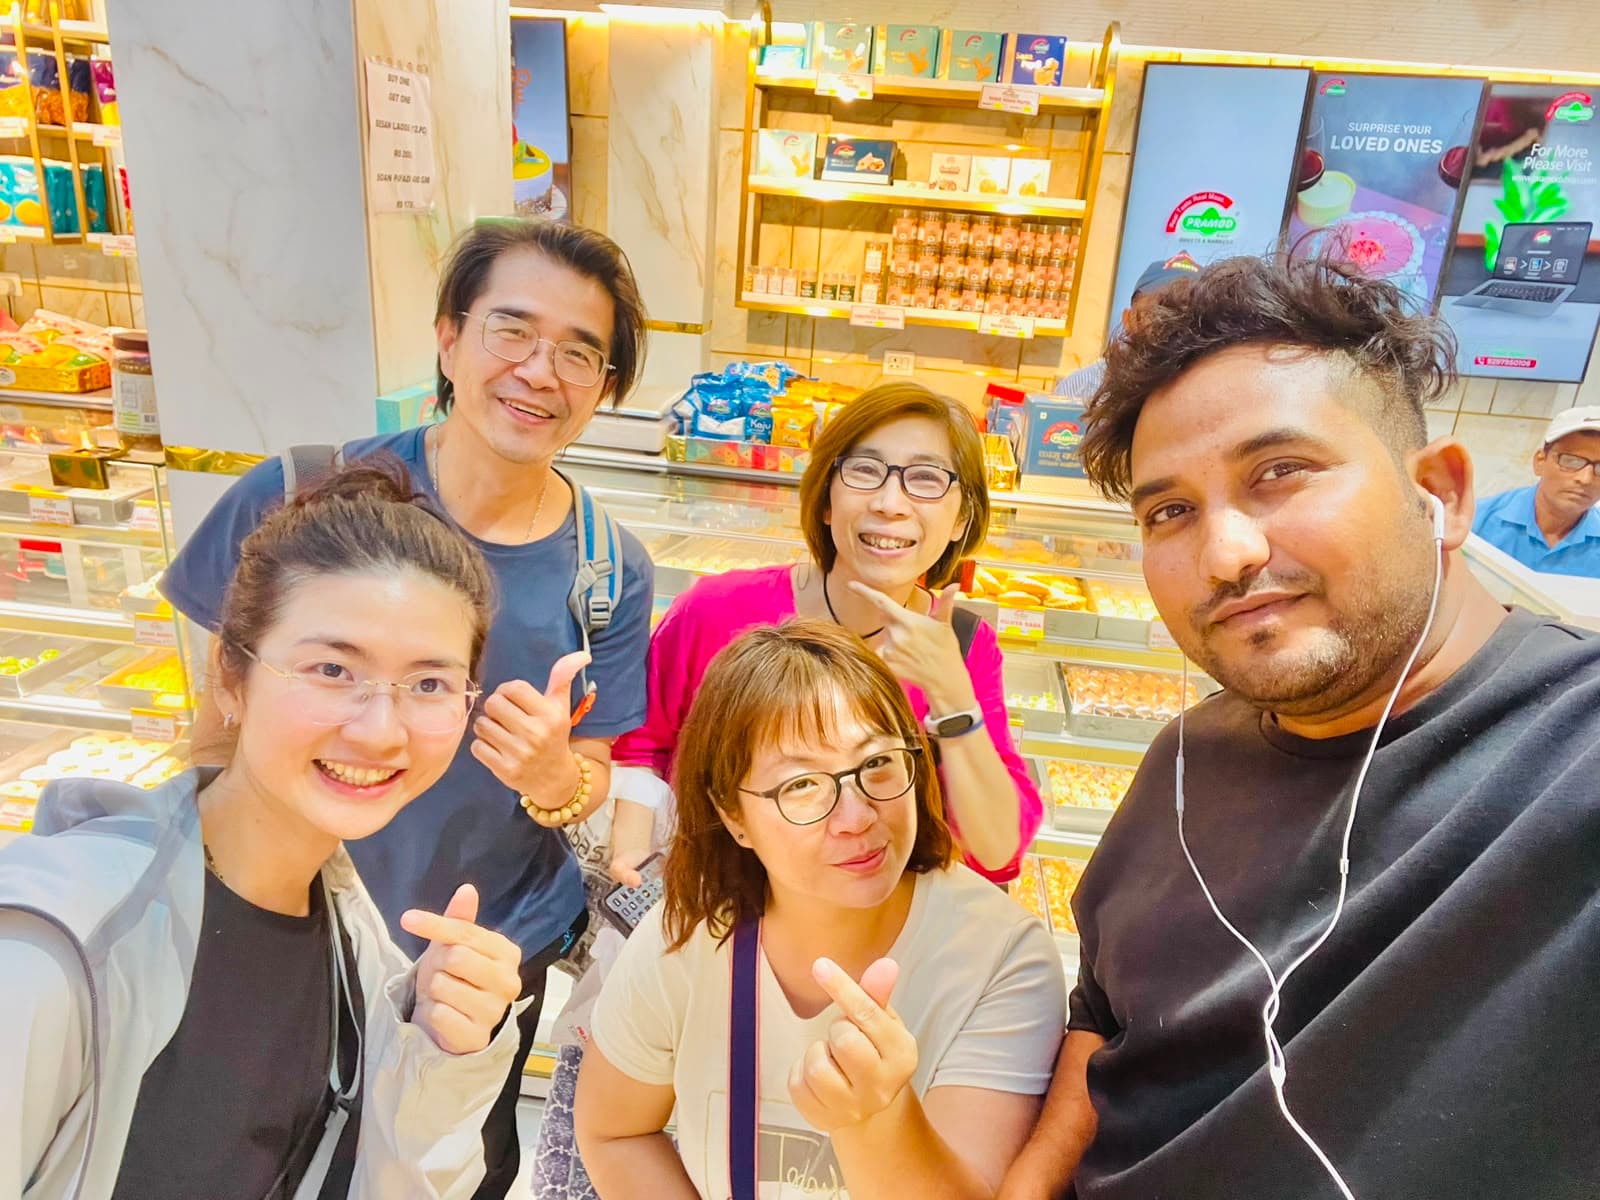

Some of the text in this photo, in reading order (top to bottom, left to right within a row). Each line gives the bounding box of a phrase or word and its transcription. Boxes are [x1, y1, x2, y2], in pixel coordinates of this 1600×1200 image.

[387, 73, 410, 87] BUY ONE
[388, 92, 411, 104] GET ONE
[1348, 122, 1432, 135] SURPRISE YOUR
[1330, 135, 1443, 154] LOVED ONES
[1530, 143, 1589, 159] For More
[1523, 156, 1593, 172] Please Visit
[1186, 217, 1233, 228] PRAMOD
[750, 418, 771, 433] Kaju
